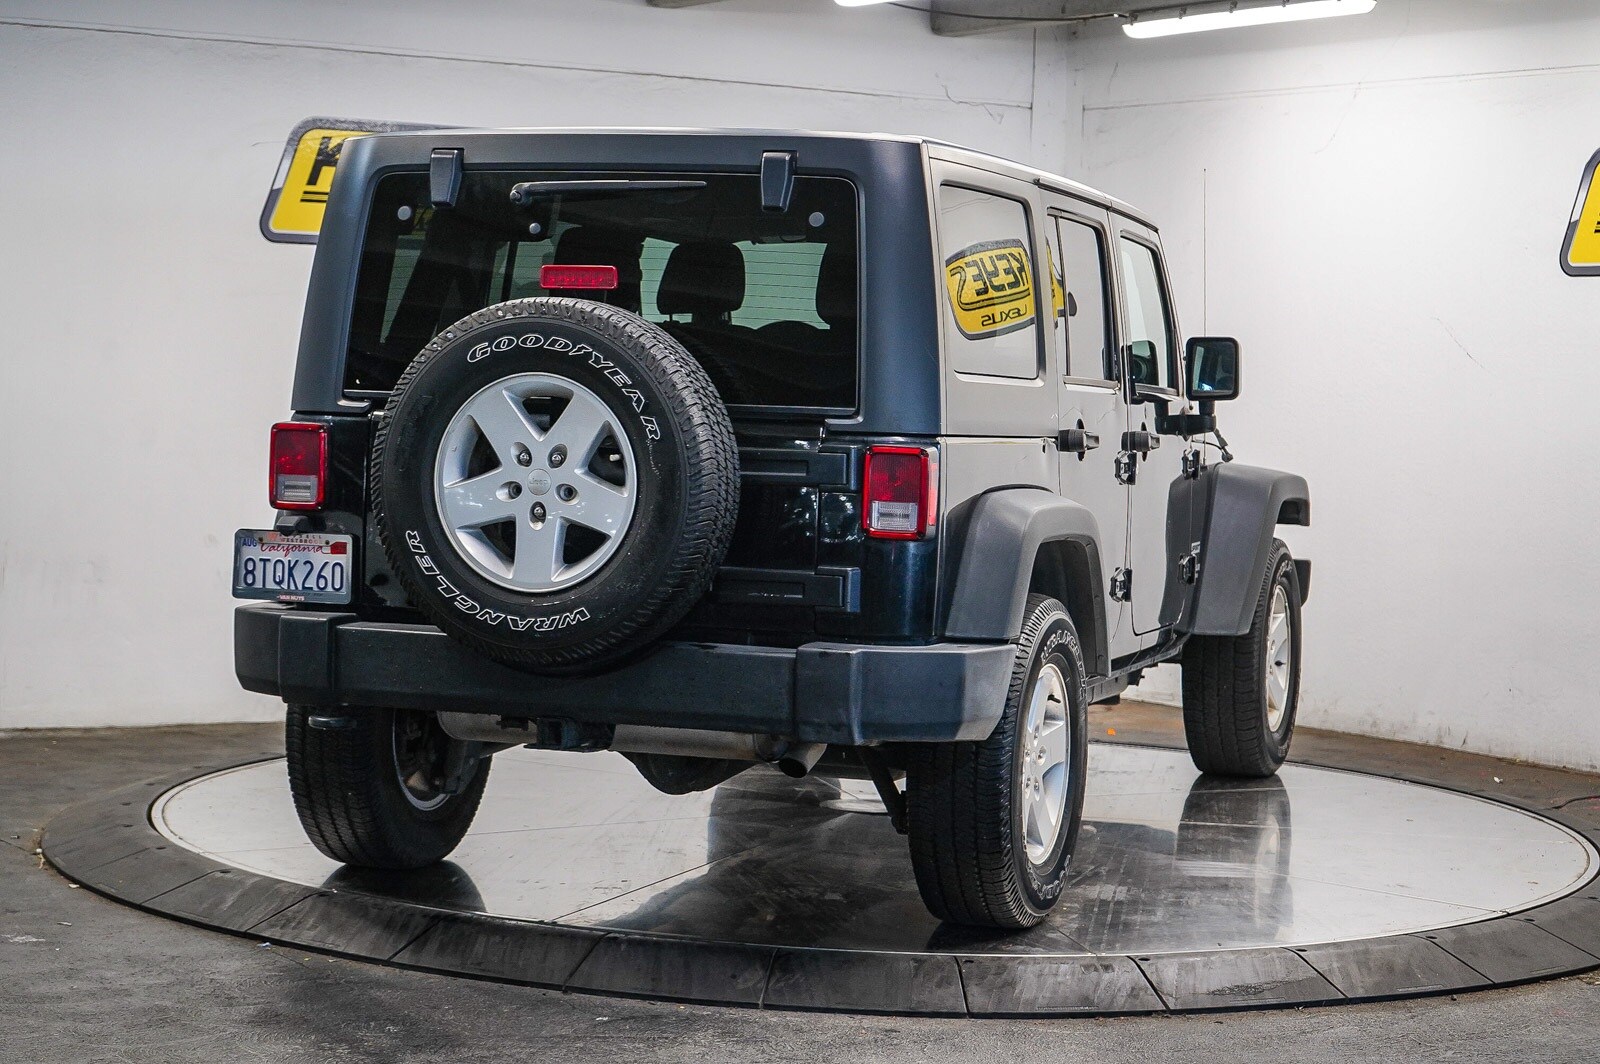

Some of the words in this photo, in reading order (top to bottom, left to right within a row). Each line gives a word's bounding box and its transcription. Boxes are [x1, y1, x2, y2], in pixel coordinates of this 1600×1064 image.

[467, 334, 661, 440] GOODYEAR
[242, 537, 258, 547] AUG
[261, 543, 324, 557] California
[243, 557, 345, 592] 8TQK260
[405, 530, 591, 632] WRANGLER
